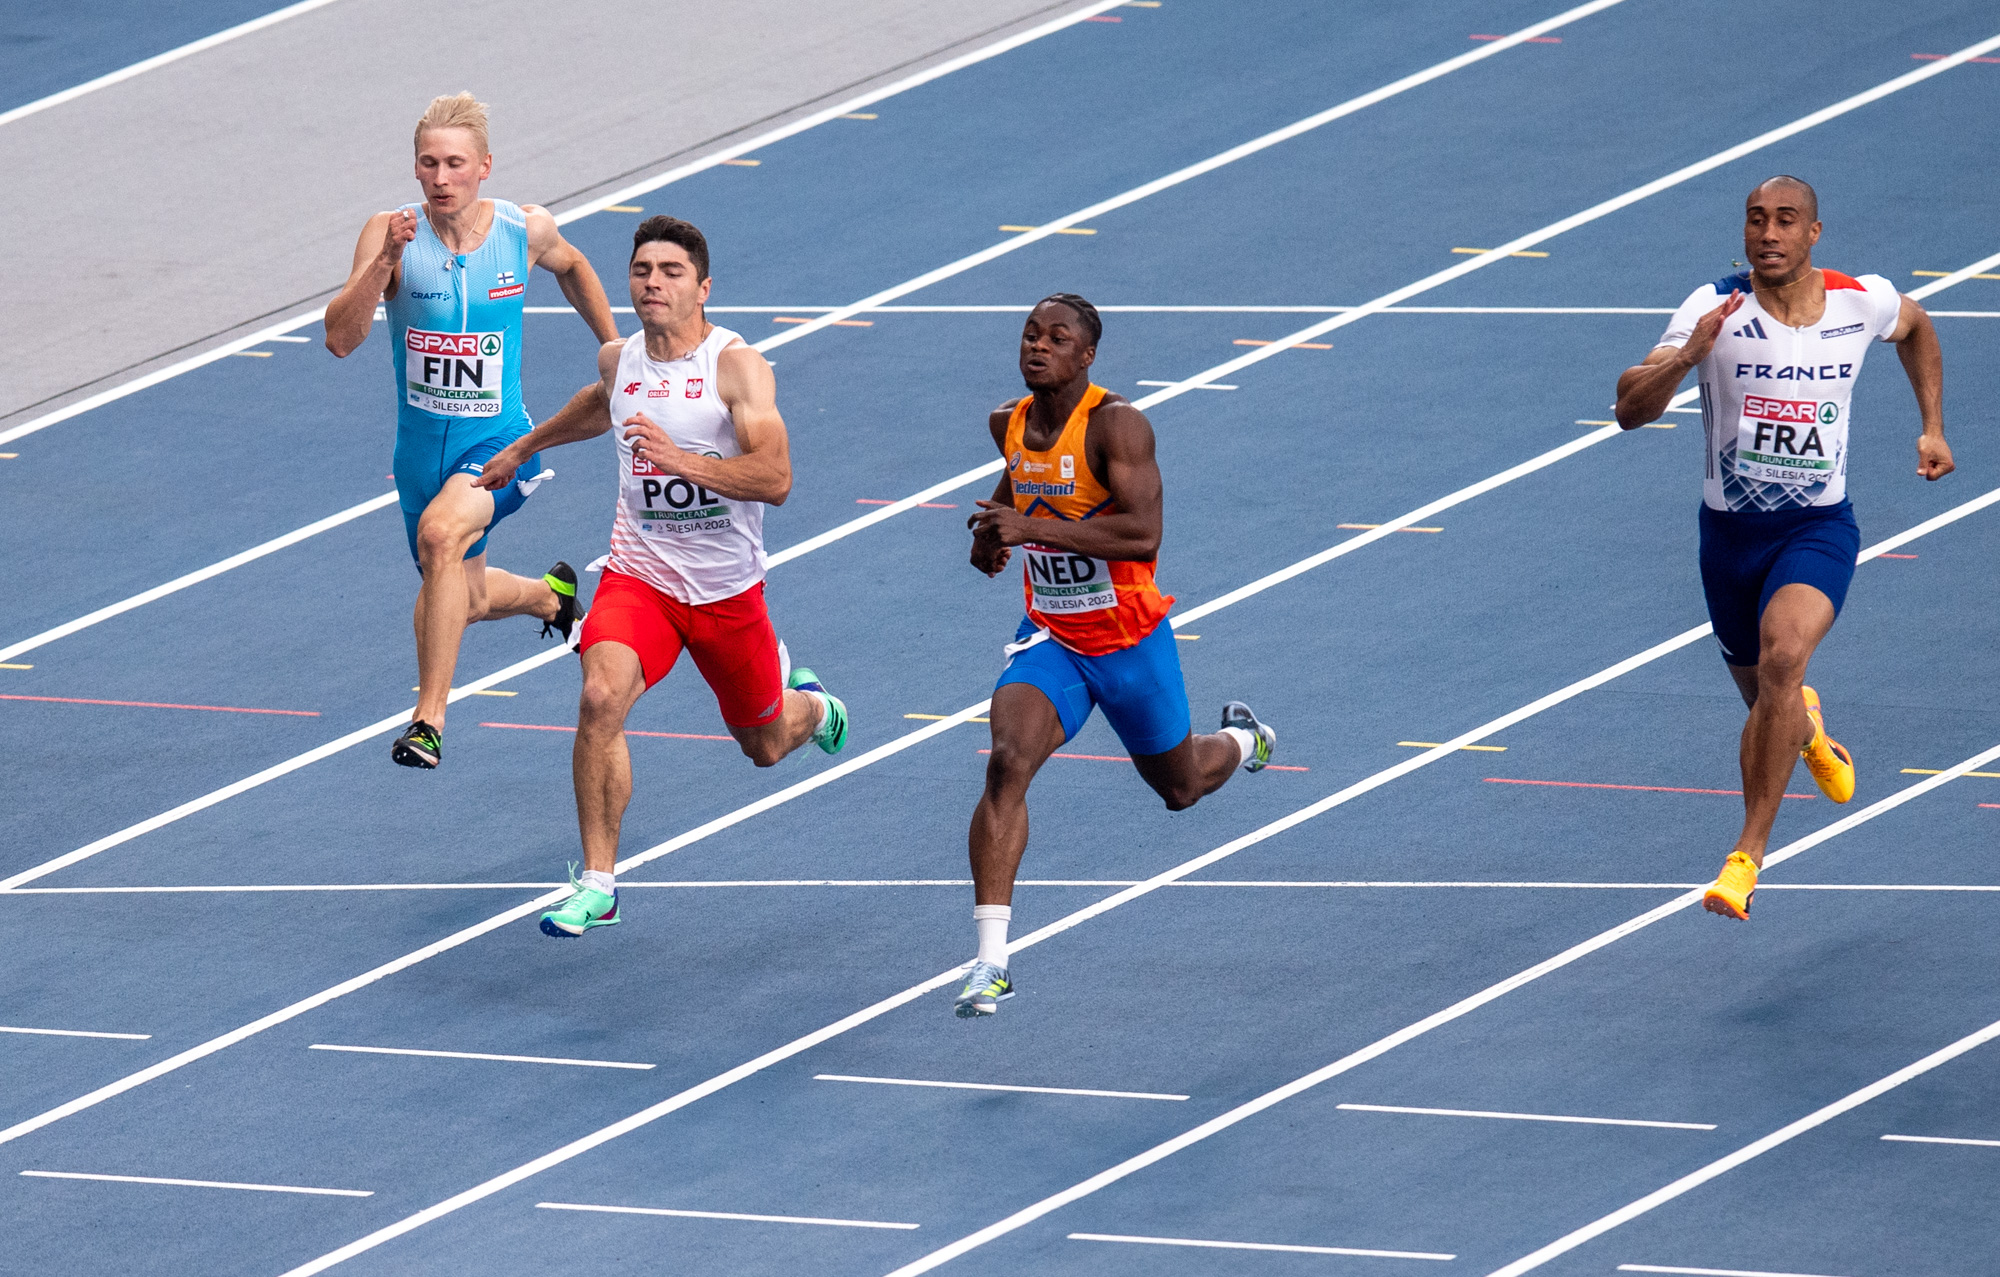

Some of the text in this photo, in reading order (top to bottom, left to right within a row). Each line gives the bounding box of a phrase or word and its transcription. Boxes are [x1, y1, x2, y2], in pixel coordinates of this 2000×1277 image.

[411, 291, 443, 300] CRAFT
[490, 286, 524, 298] motonet
[408, 333, 476, 353] SPAR
[424, 356, 483, 388] FIN
[1735, 363, 1853, 380] FRANCE
[428, 388, 448, 397] RUN
[623, 382, 642, 395] 4F
[432, 401, 500, 413] SILESIA 2023
[1745, 399, 1815, 420] SPAR
[1753, 422, 1824, 457] FRA
[1761, 456, 1782, 465] RUN
[1766, 468, 1805, 480] SILESIA
[643, 479, 718, 509] POL
[666, 522, 702, 534] SILESIA
[704, 519, 731, 530] 2023
[1028, 553, 1096, 584] NED
[1049, 594, 1114, 609] SILESIA 2023
